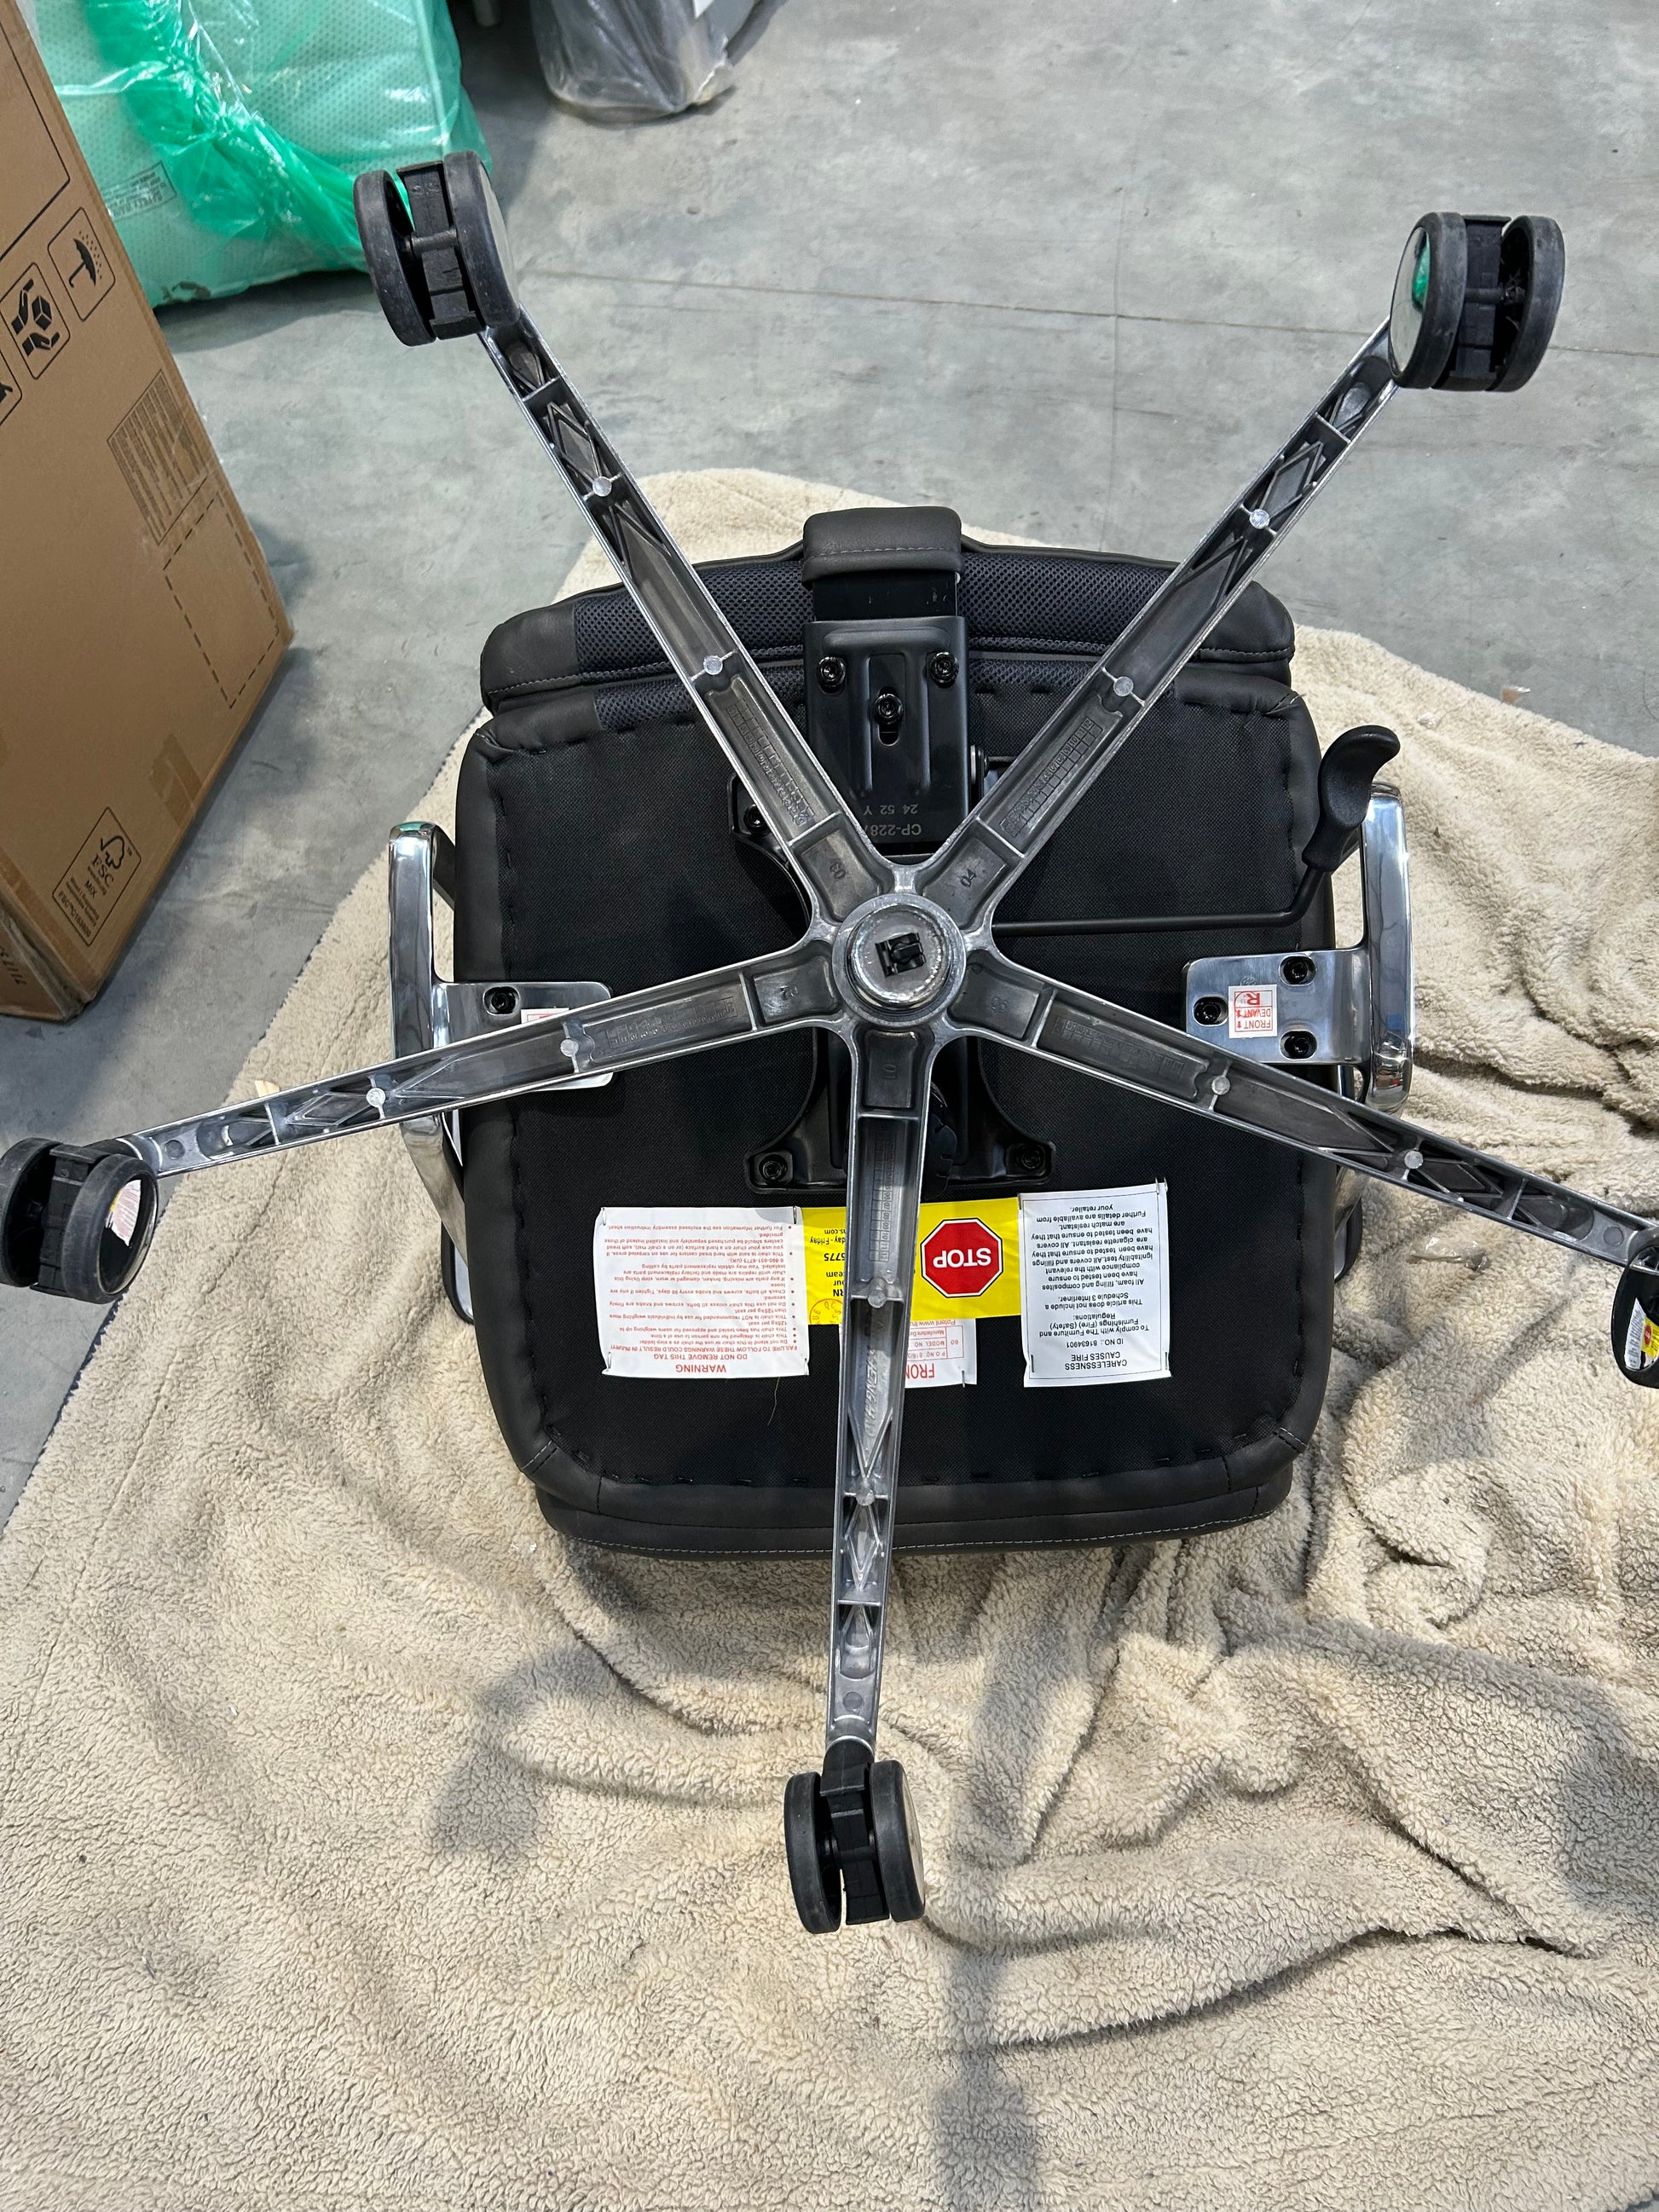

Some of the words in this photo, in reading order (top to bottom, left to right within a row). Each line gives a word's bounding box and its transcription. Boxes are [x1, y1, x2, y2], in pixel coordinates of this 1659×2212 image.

[880, 805, 895, 815] 52
[902, 804, 918, 815] 24
[1246, 993, 1260, 1006] R
[1244, 1008, 1270, 1018] DEVANT
[1244, 1020, 1270, 1030] FRONT
[810, 1236, 830, 1245] Friday
[1103, 1236, 1134, 1245] cigarette
[932, 1247, 991, 1268] STOP
[1119, 1252, 1153, 1262] ignitability
[1042, 1282, 1081, 1291] composites
[1097, 1292, 1129, 1301] Schedule
[1073, 1312, 1116, 1320] Regulations:
[1049, 1321, 1078, 1330] (Safety)
[1078, 1320, 1097, 1329] (Fire)
[1115, 1325, 1140, 1333] comply
[1066, 1340, 1097, 1349] 81634901
[1090, 1351, 1120, 1360] CAUSES
[675, 1364, 726, 1372] WARNING
[1065, 1359, 1127, 1371] CARELESSNESS
[905, 1363, 934, 1379] FRON
